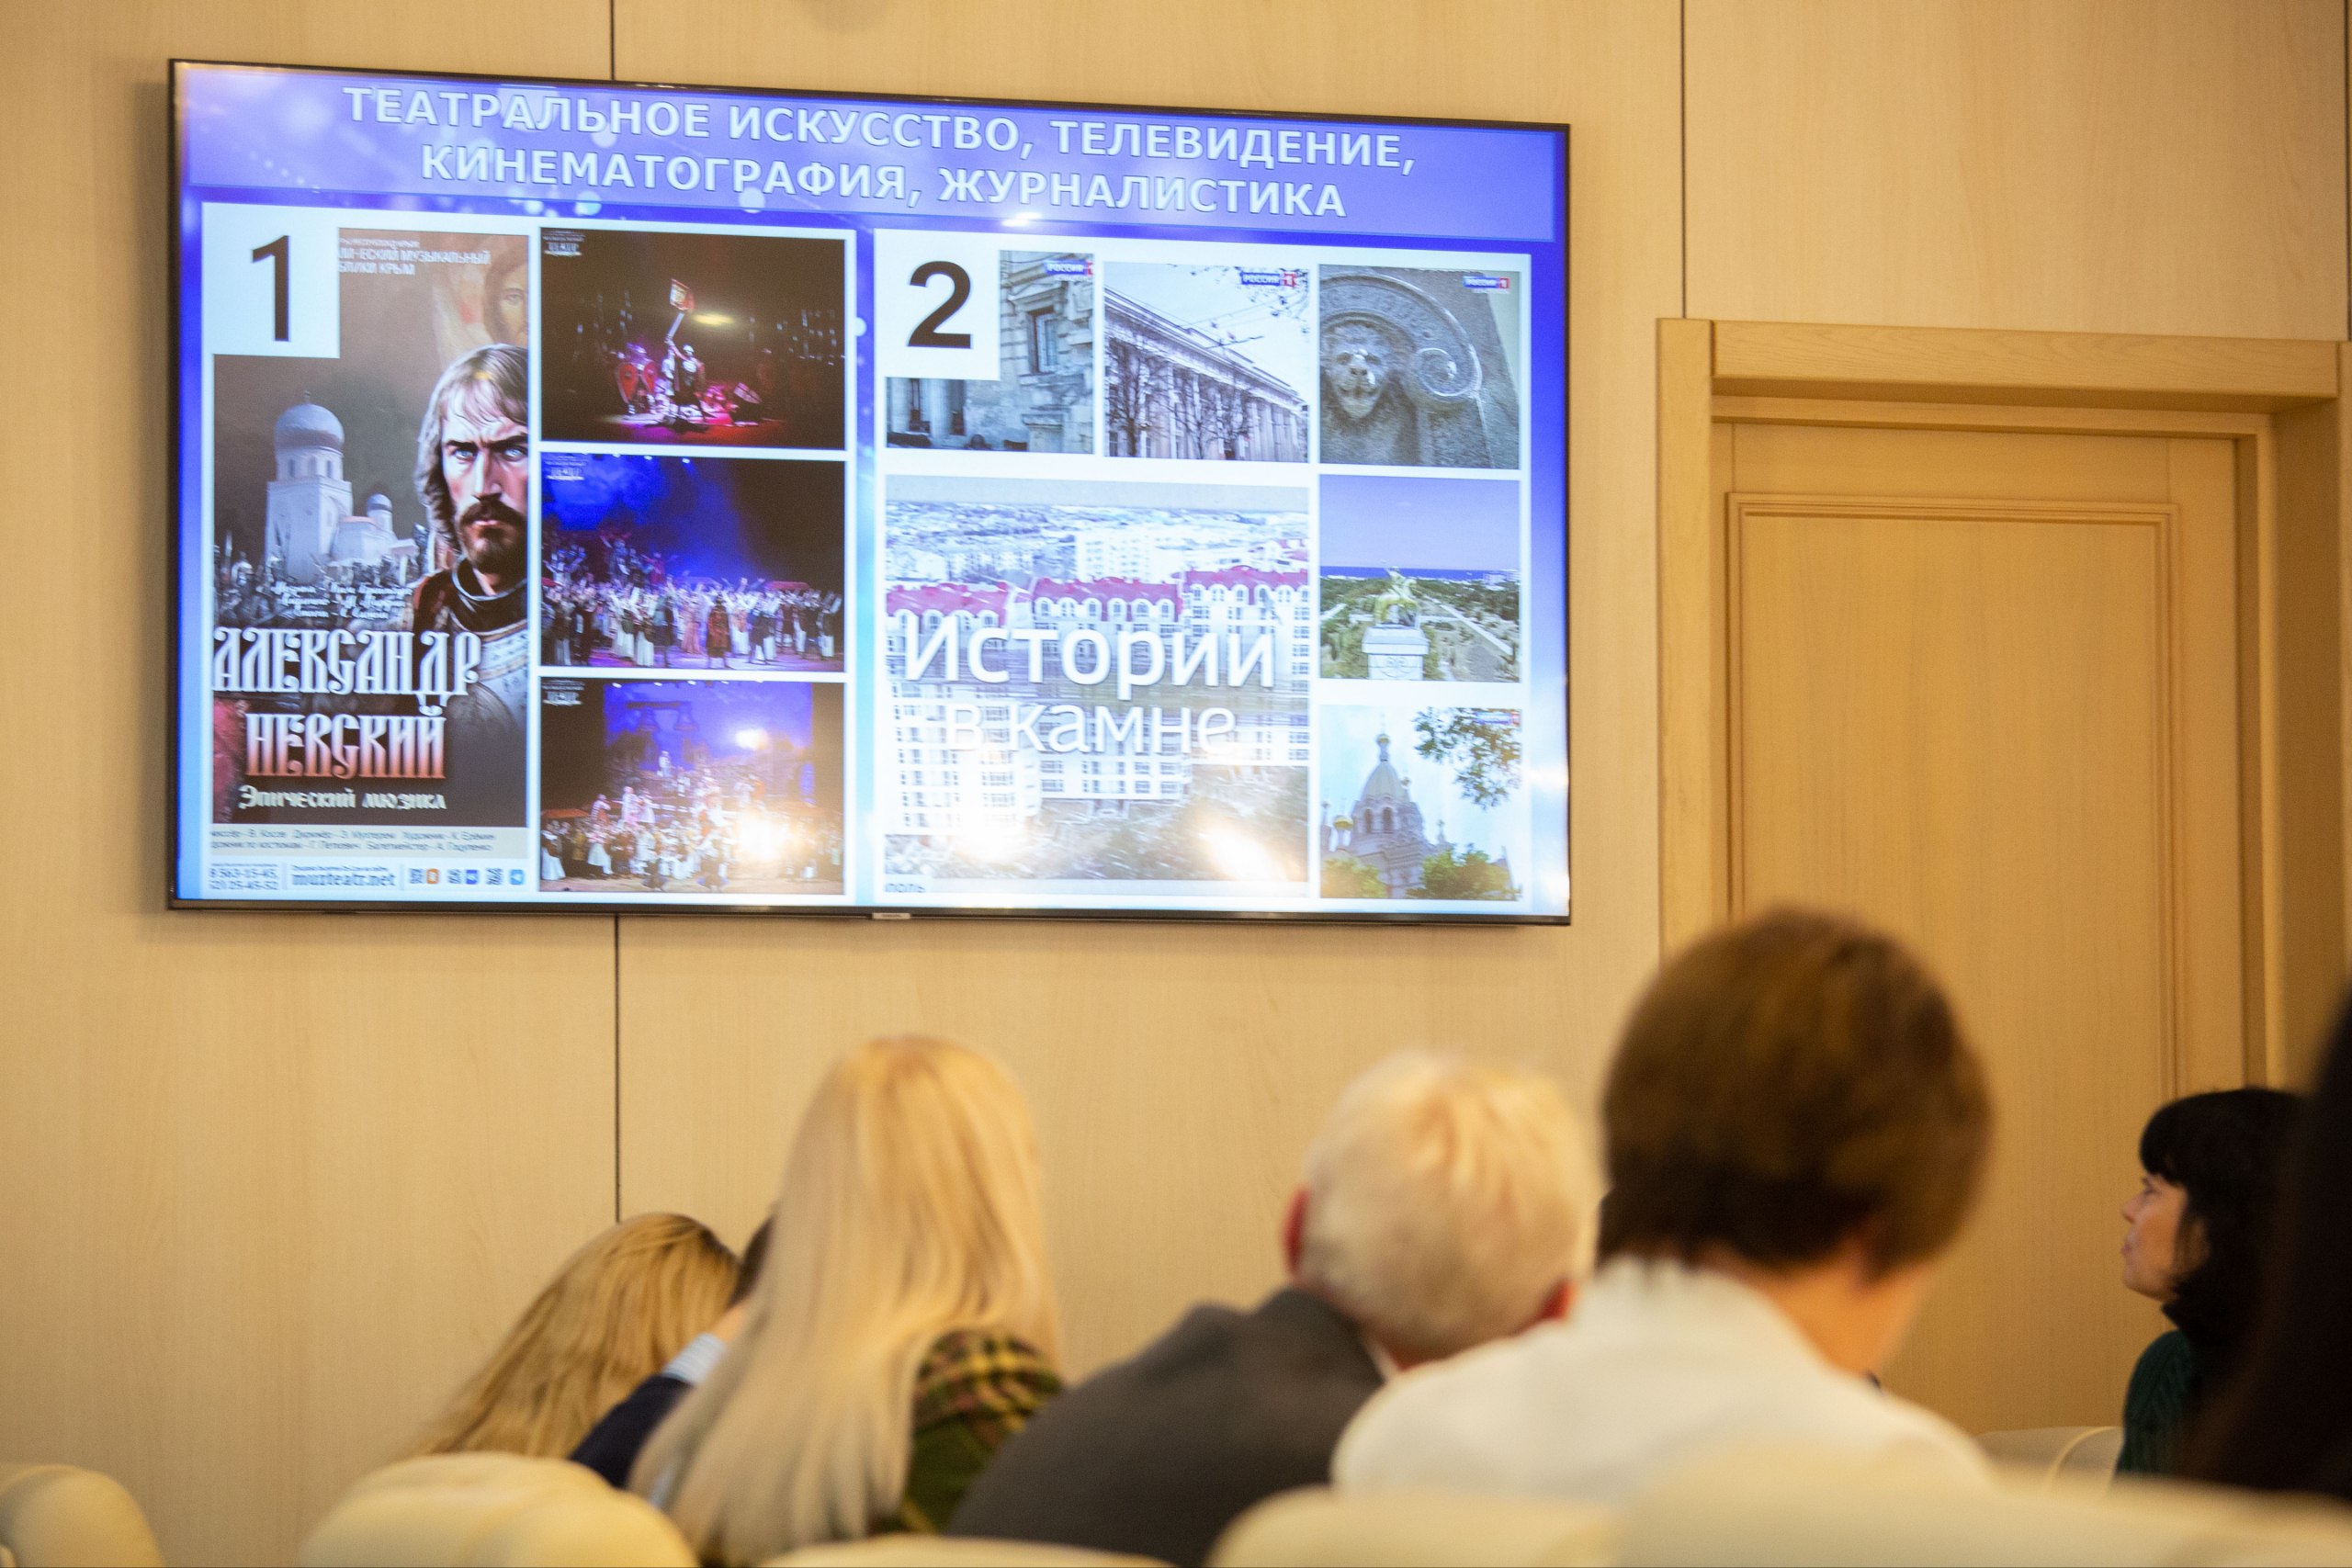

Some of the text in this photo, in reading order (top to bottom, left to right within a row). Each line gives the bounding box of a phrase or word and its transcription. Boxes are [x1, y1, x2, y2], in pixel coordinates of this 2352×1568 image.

[343, 86, 1416, 176] ТЕАТРАЛЬНОЕ ИСКУССТВО, ТЕЛЕВИДЕНИЕ,
[421, 144, 1348, 218] КИНЕМАТОГРАФИЯ, ЖУРНАЛИСТИКА
[252, 234, 289, 343] 1
[907, 260, 972, 350] 2
[212, 626, 482, 707] АЛЕКСАНДР
[904, 616, 1275, 701] Истории
[244, 705, 447, 780] НЕВСКИЙ
[945, 702, 1237, 754] в камне
[238, 784, 356, 809] Эпический
